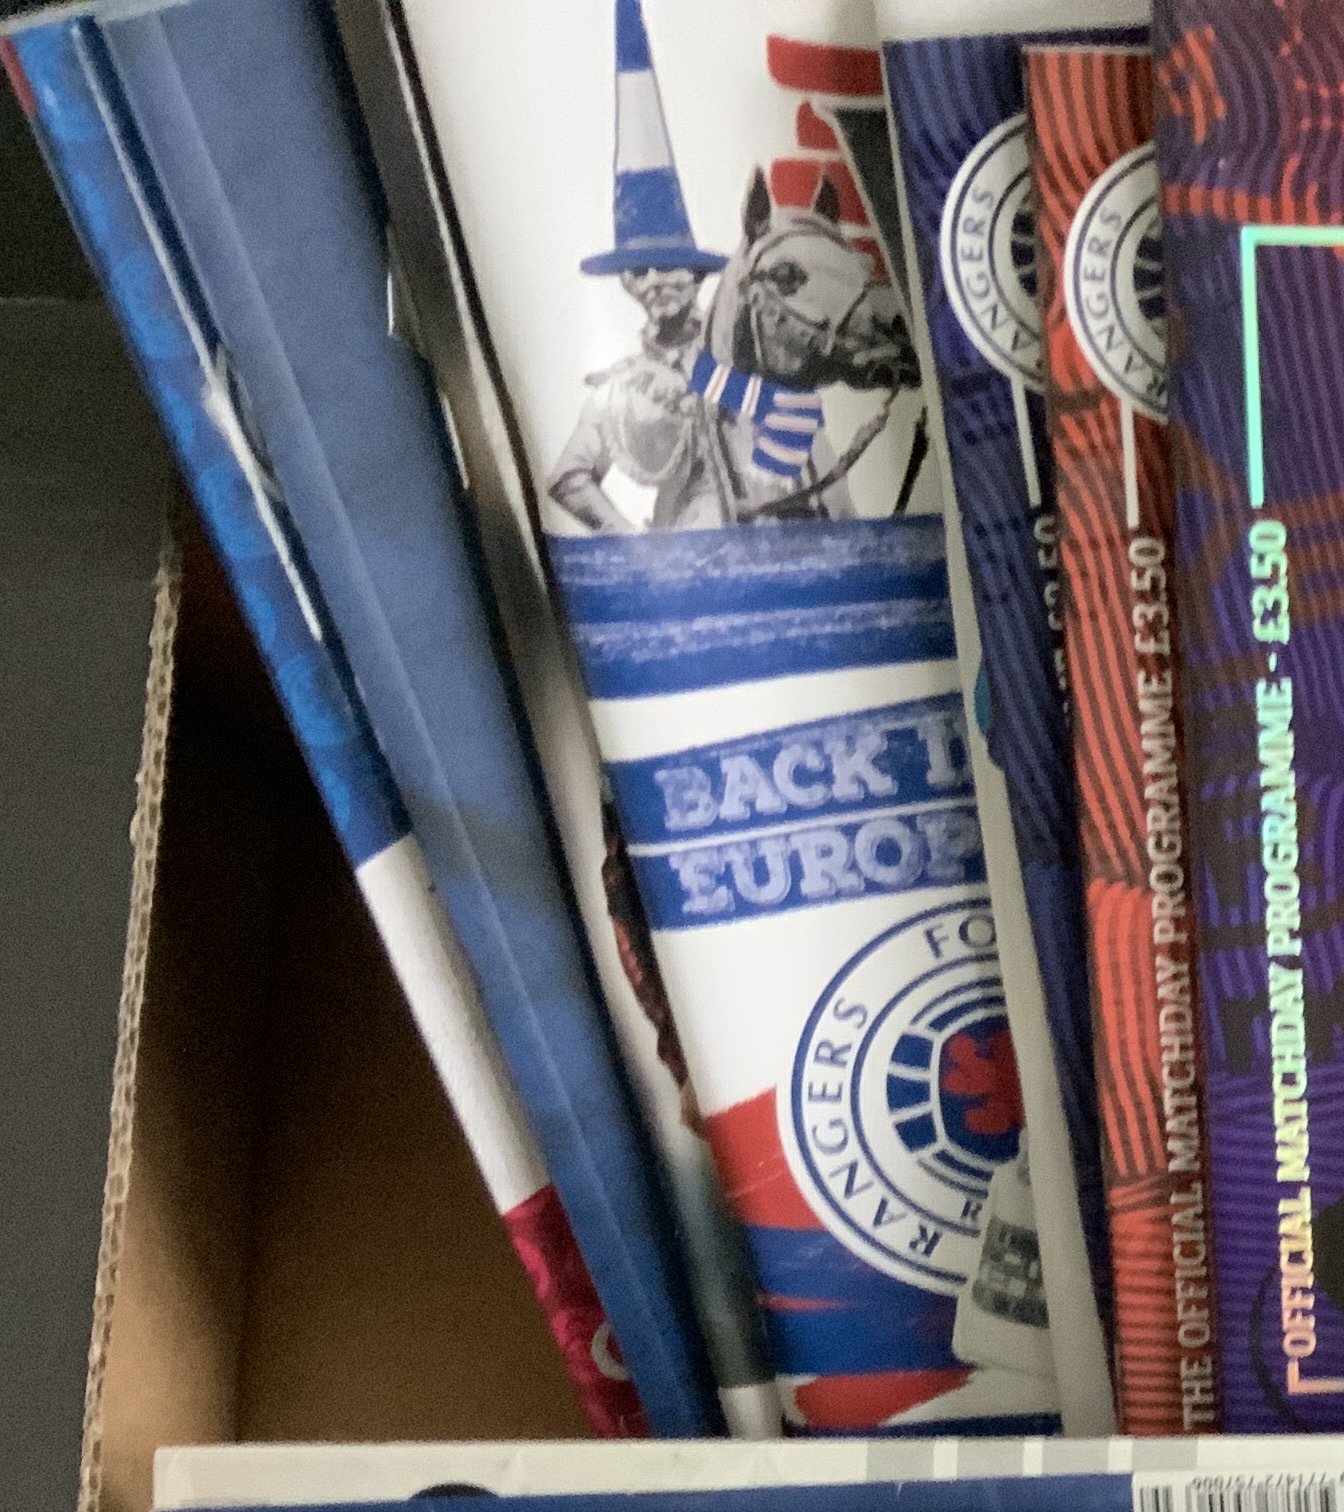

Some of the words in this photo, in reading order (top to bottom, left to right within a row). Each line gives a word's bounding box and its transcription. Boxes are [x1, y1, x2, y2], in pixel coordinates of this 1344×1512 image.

[960, 186, 1041, 370] ANGERS
[1127, 537, 1172, 657] £3.50
[1248, 518, 1291, 645] £3.50
[654, 727, 900, 833] BACK
[668, 812, 985, 915] EUROP
[1136, 668, 1189, 946] PROGRAMME
[1255, 677, 1302, 957] PROGRAMME
[806, 996, 943, 1260] RANGERS
[1155, 955, 1203, 1174] MATCHDAY
[1267, 960, 1311, 1182] MATCHDAY
[1168, 1180, 1213, 1349] OFFICIAL
[1277, 1185, 1318, 1359] OFFICIAL
[1178, 1354, 1216, 1432] THE
